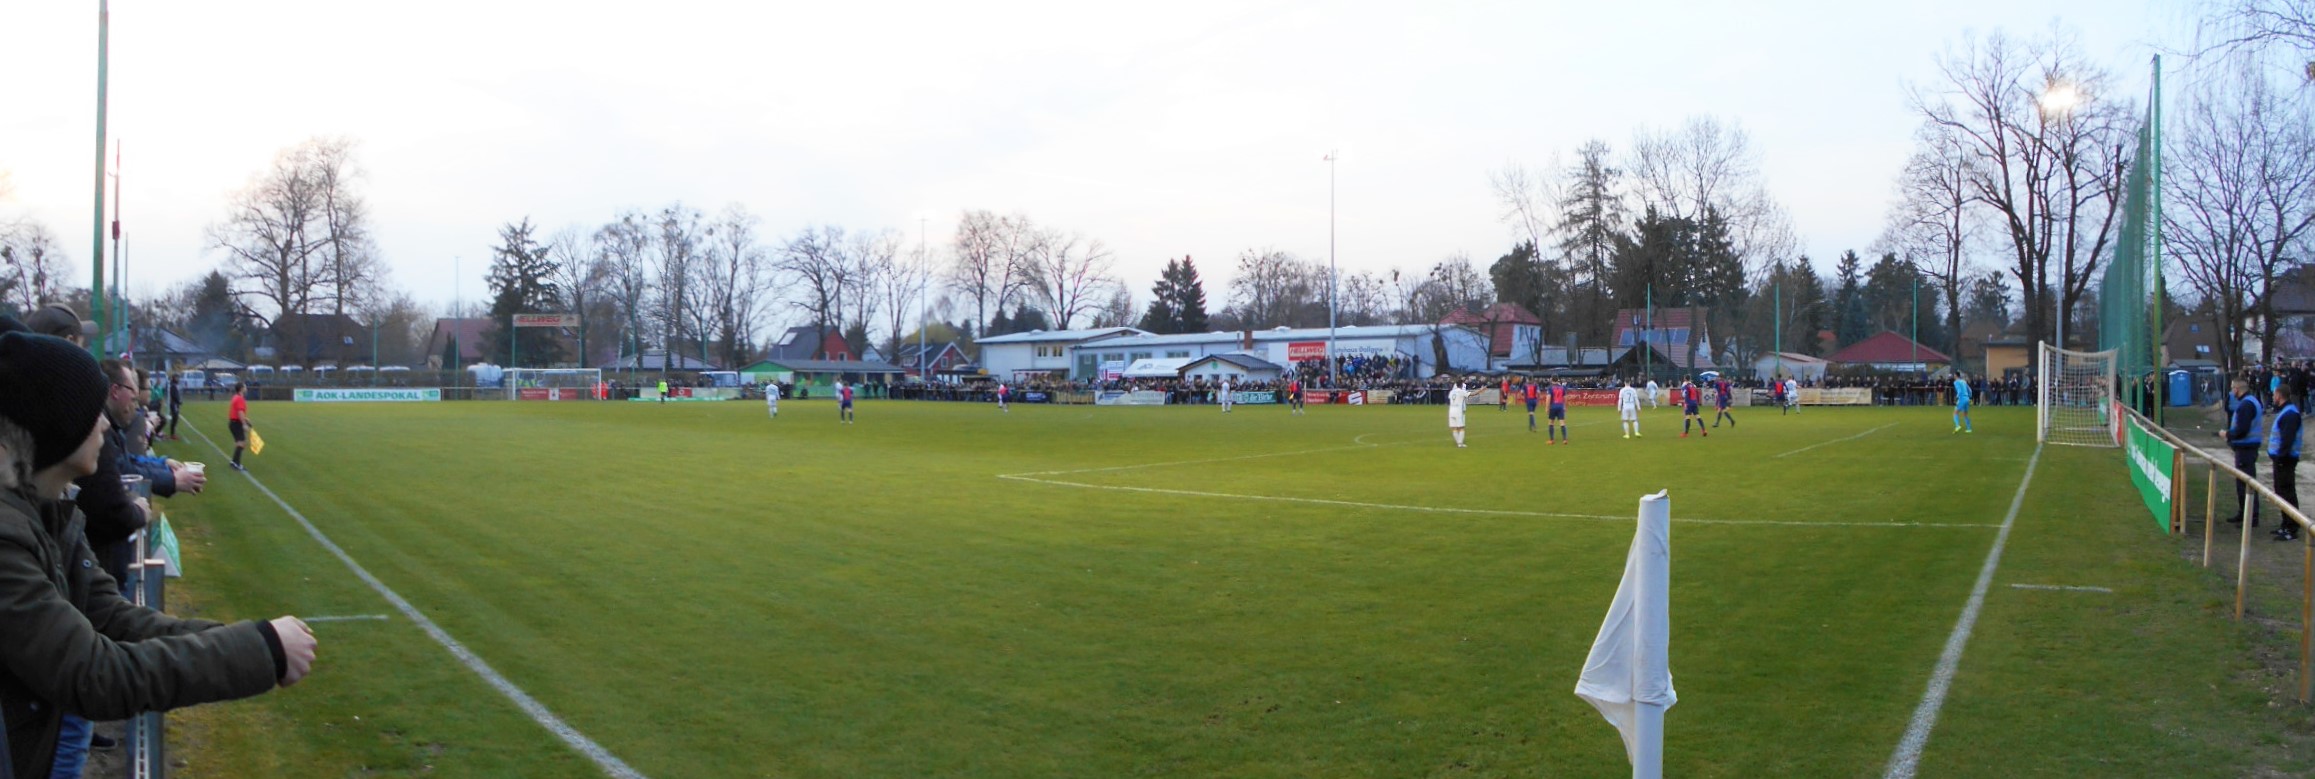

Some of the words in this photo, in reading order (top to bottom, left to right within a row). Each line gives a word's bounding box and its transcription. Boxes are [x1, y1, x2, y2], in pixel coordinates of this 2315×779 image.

[315, 391, 420, 400] AOK-LANDESPOKAL
[1583, 392, 1616, 400] Zentrum
[1627, 392, 1633, 401] 7
